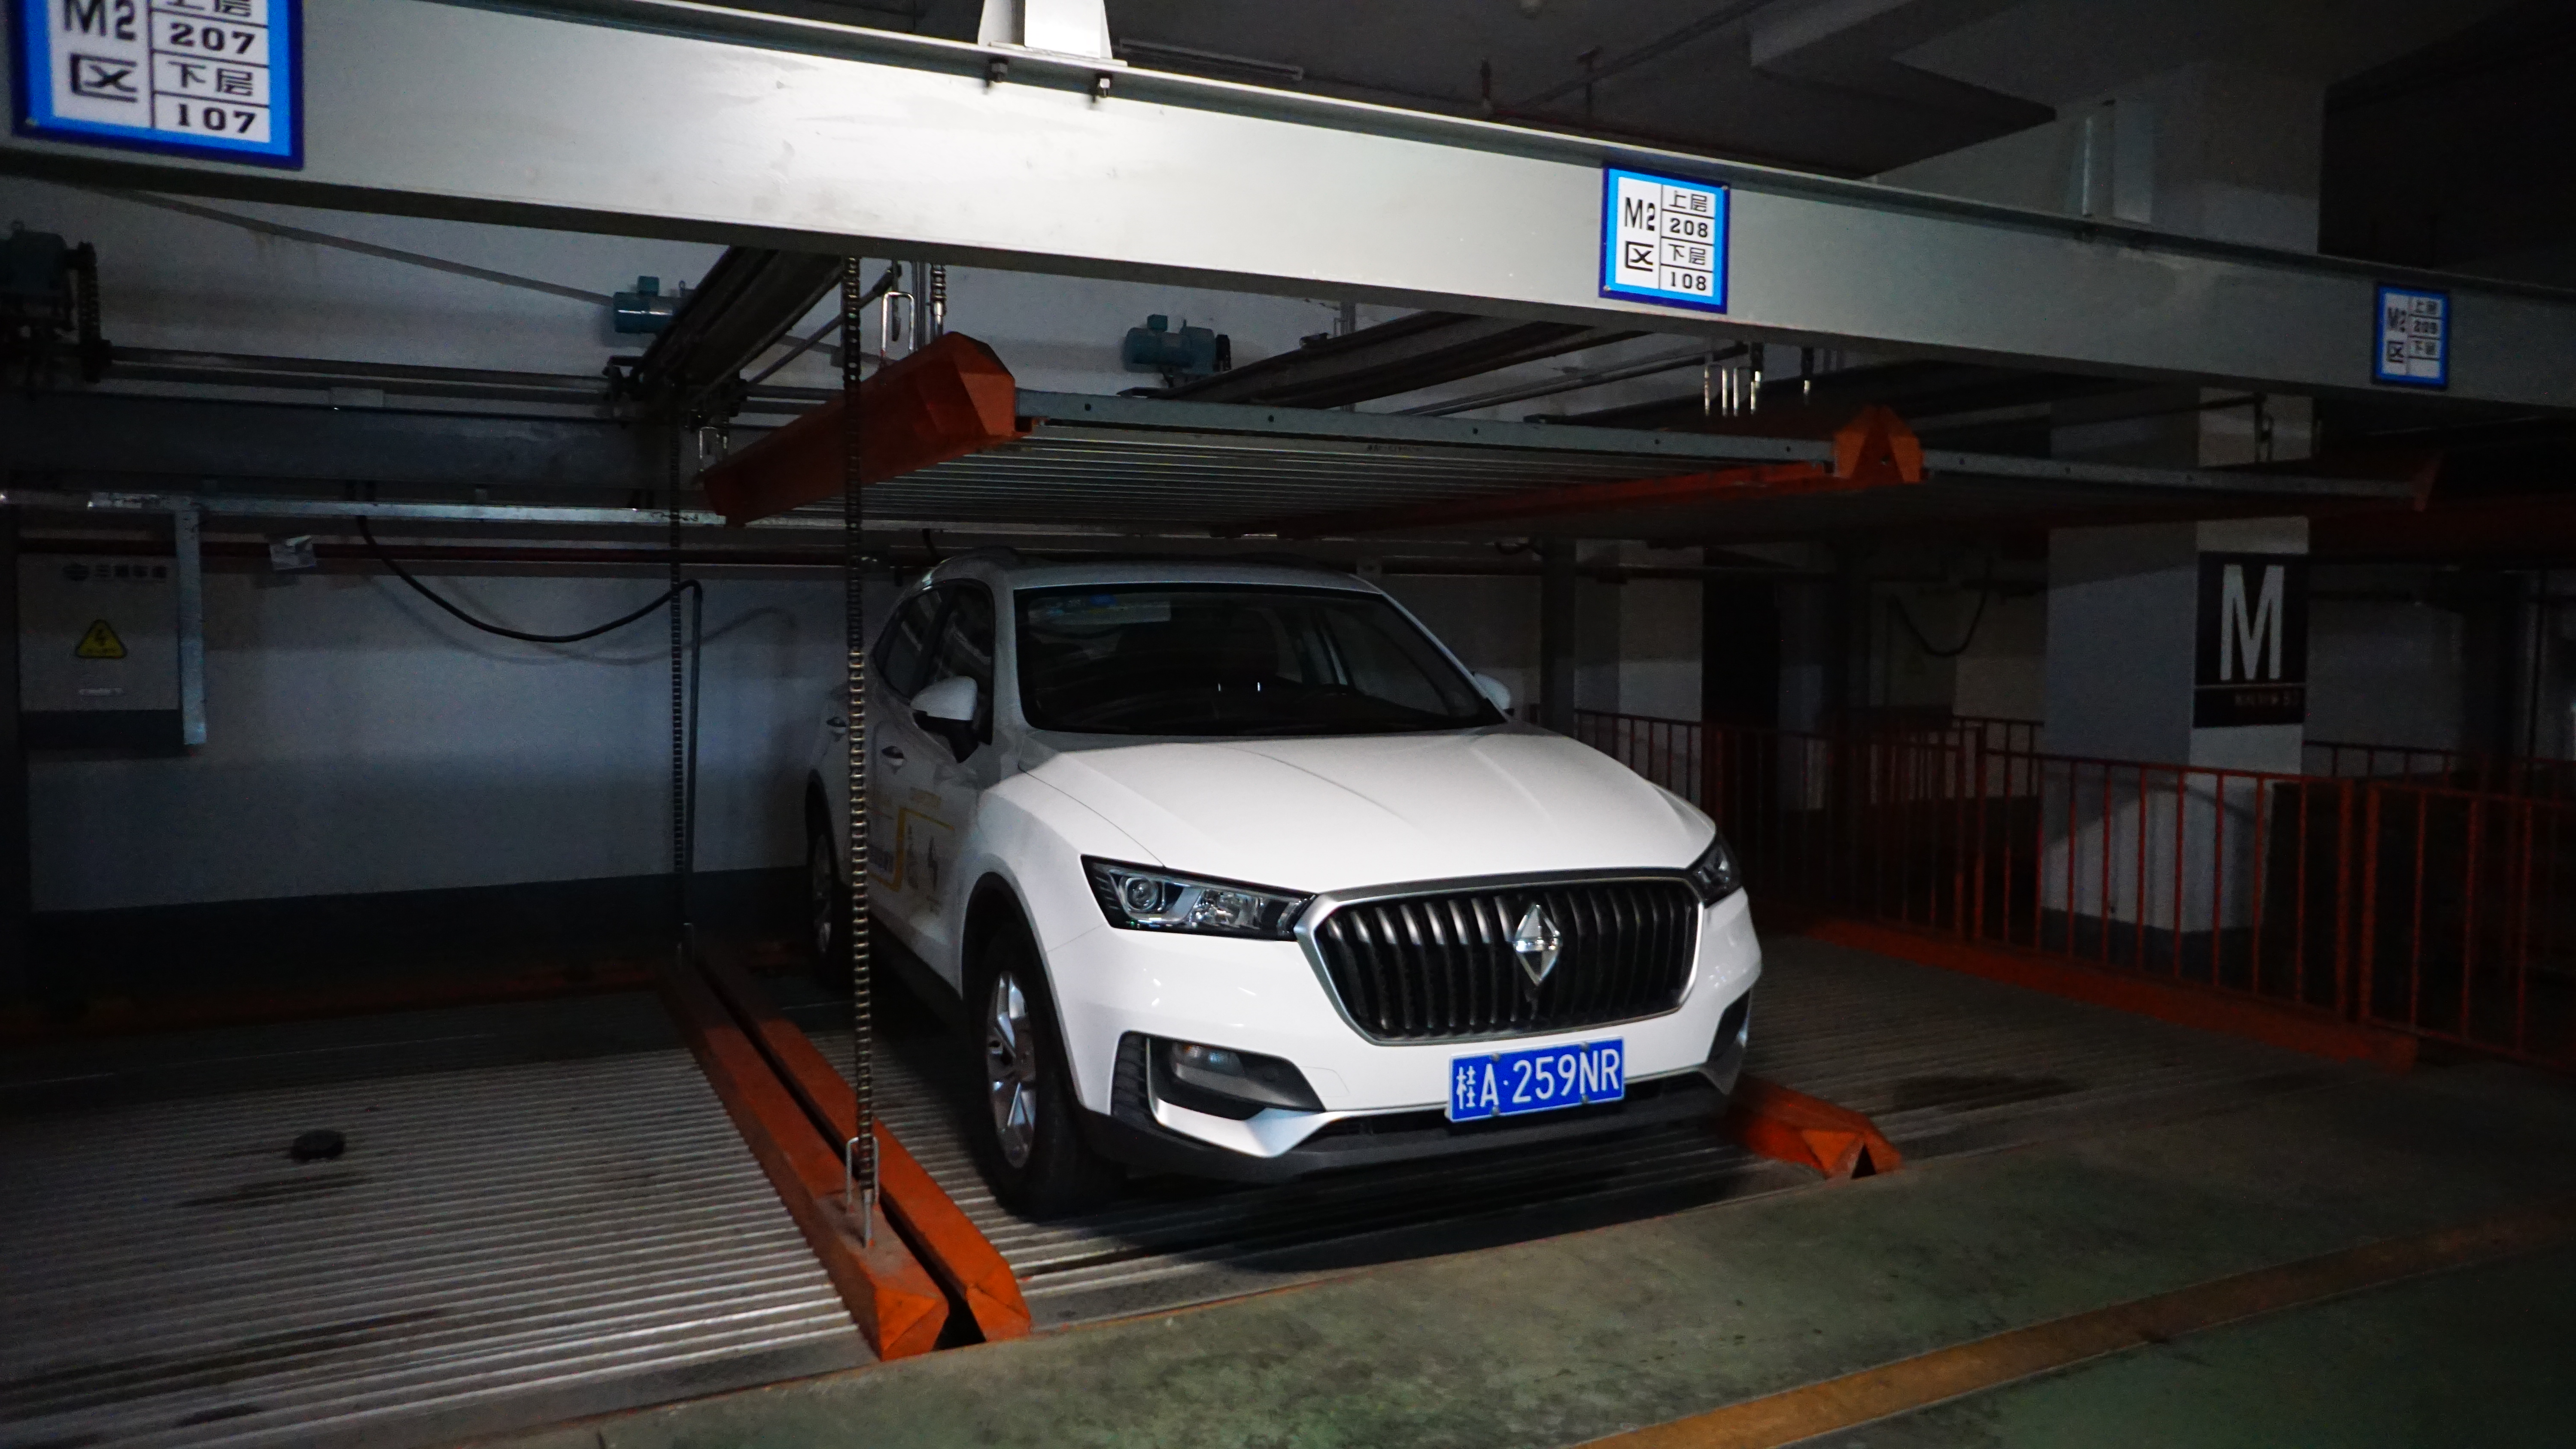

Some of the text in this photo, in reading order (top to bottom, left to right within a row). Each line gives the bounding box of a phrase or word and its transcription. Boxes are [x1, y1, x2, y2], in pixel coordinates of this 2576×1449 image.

[64, 0, 136, 41] M2
[170, 22, 255, 55] 207
[69, 53, 138, 103] 区
[167, 61, 254, 97] 下层
[178, 103, 257, 133] 107
[1624, 197, 1656, 231] M2
[1668, 190, 1707, 213] 上层
[1669, 217, 1708, 238] 208
[1624, 240, 1654, 272] 区
[1668, 243, 1706, 266] 下层
[1671, 271, 1707, 291] 108
[2387, 307, 2406, 333] M2
[2386, 340, 2404, 364] 区
[2220, 563, 2285, 681] M
